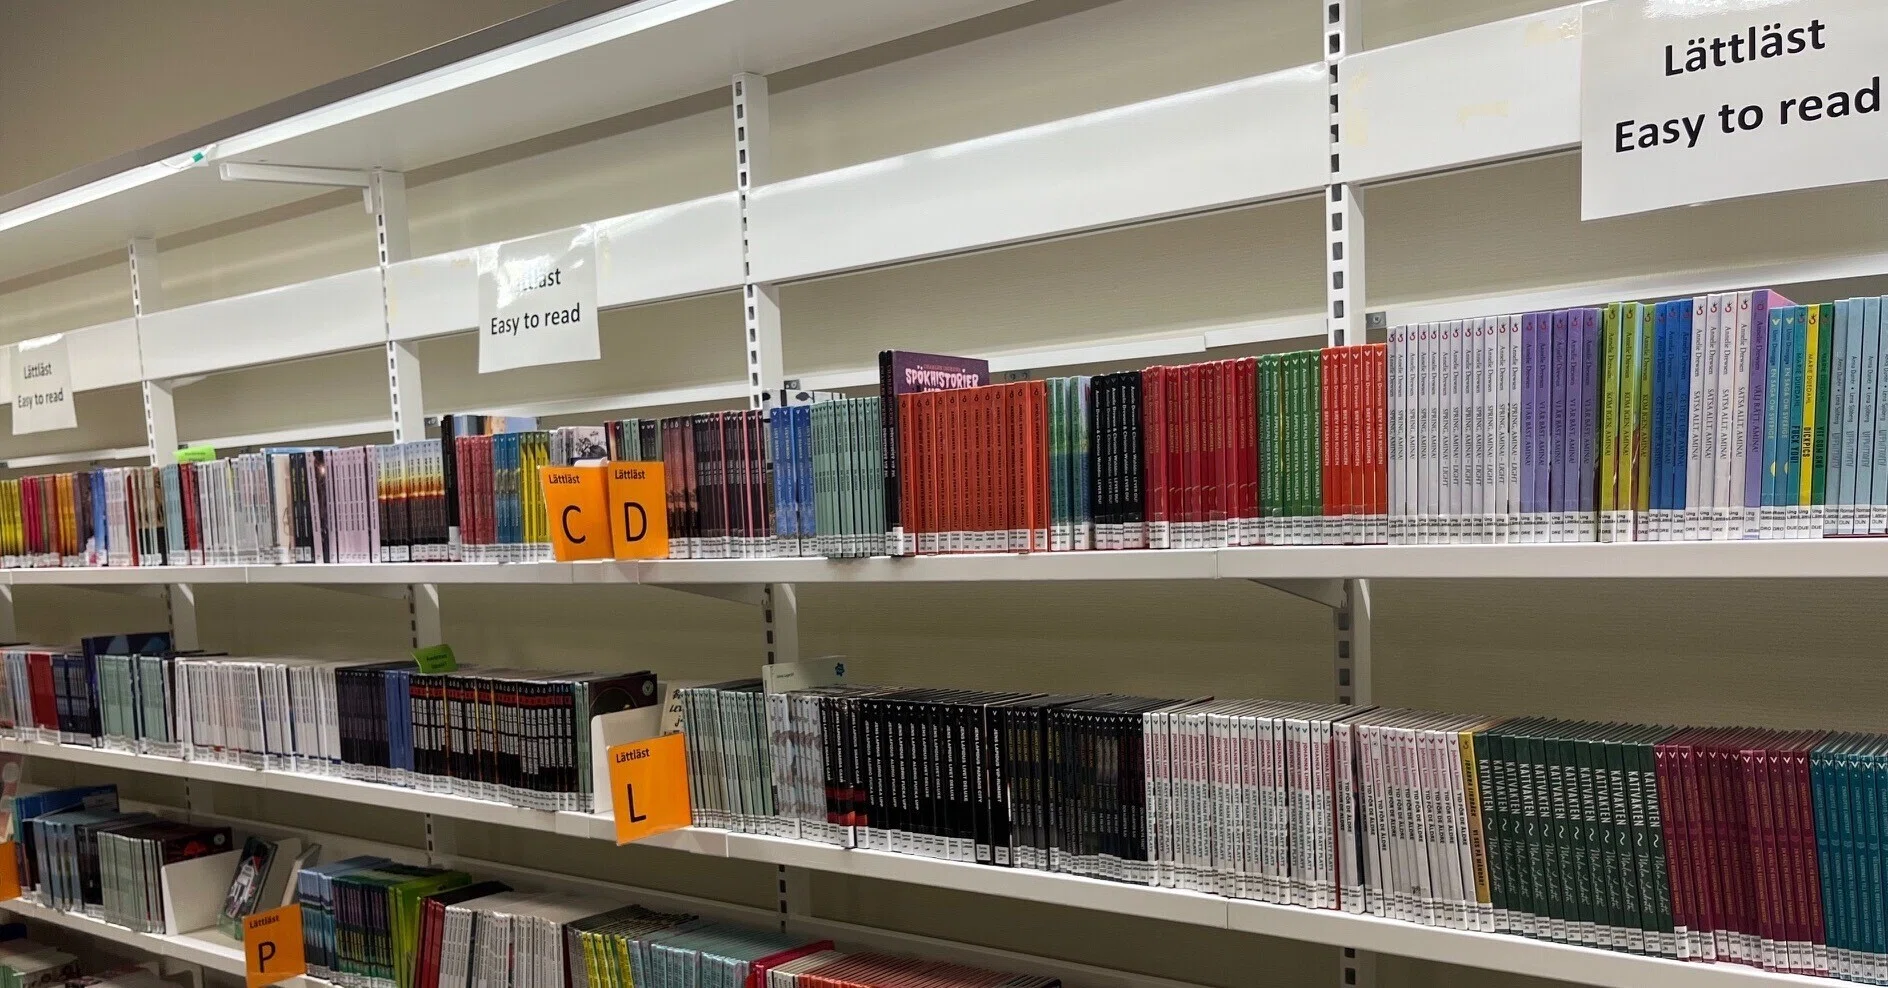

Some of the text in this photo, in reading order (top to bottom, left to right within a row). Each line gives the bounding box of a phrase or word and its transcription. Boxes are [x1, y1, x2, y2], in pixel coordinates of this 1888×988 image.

[1665, 19, 1826, 76] Lättläst
[1616, 76, 1880, 153] Easy to read
[491, 302, 580, 336] Easy to read
[24, 362, 52, 379] Lättläst
[905, 365, 979, 388] SPÖKHISTORIER
[1771, 369, 1777, 378] EN
[18, 387, 64, 409] Easy to read
[1769, 400, 1776, 410] OM
[1802, 426, 1812, 457] DICKPICS
[1816, 440, 1824, 453] SOM
[1817, 426, 1825, 437] VIT
[549, 474, 580, 484] Lättläst
[615, 469, 645, 480] Lättläst
[1815, 456, 1824, 468] SNÖ
[562, 505, 586, 544] C
[624, 502, 647, 542] D
[616, 748, 650, 763] Lättläst
[627, 784, 646, 823] L
[1479, 760, 1493, 811] KATTVAKTEN
[1493, 760, 1508, 812] KATTVAKTEN
[1506, 762, 1521, 814] KATTVAKTEN
[1520, 764, 1535, 816] KATTVAKTEN
[1535, 764, 1550, 817] KATTVAKTEN
[1550, 766, 1565, 819] KATTVAKTEN
[1565, 766, 1580, 820] KATTVAKTEN
[1580, 768, 1595, 821] KATTVAKTEN
[1595, 769, 1611, 823] KATTVAKTEN
[1611, 770, 1626, 825] KATTVAKTEN
[1628, 771, 1644, 826] KATTVAKTEN
[1644, 772, 1660, 827] KATTVAKTEN
[1417, 822, 1425, 842] ÄLDRE
[1475, 848, 1482, 856] PÅ
[249, 915, 280, 928] Lättläst
[258, 941, 276, 973] P
